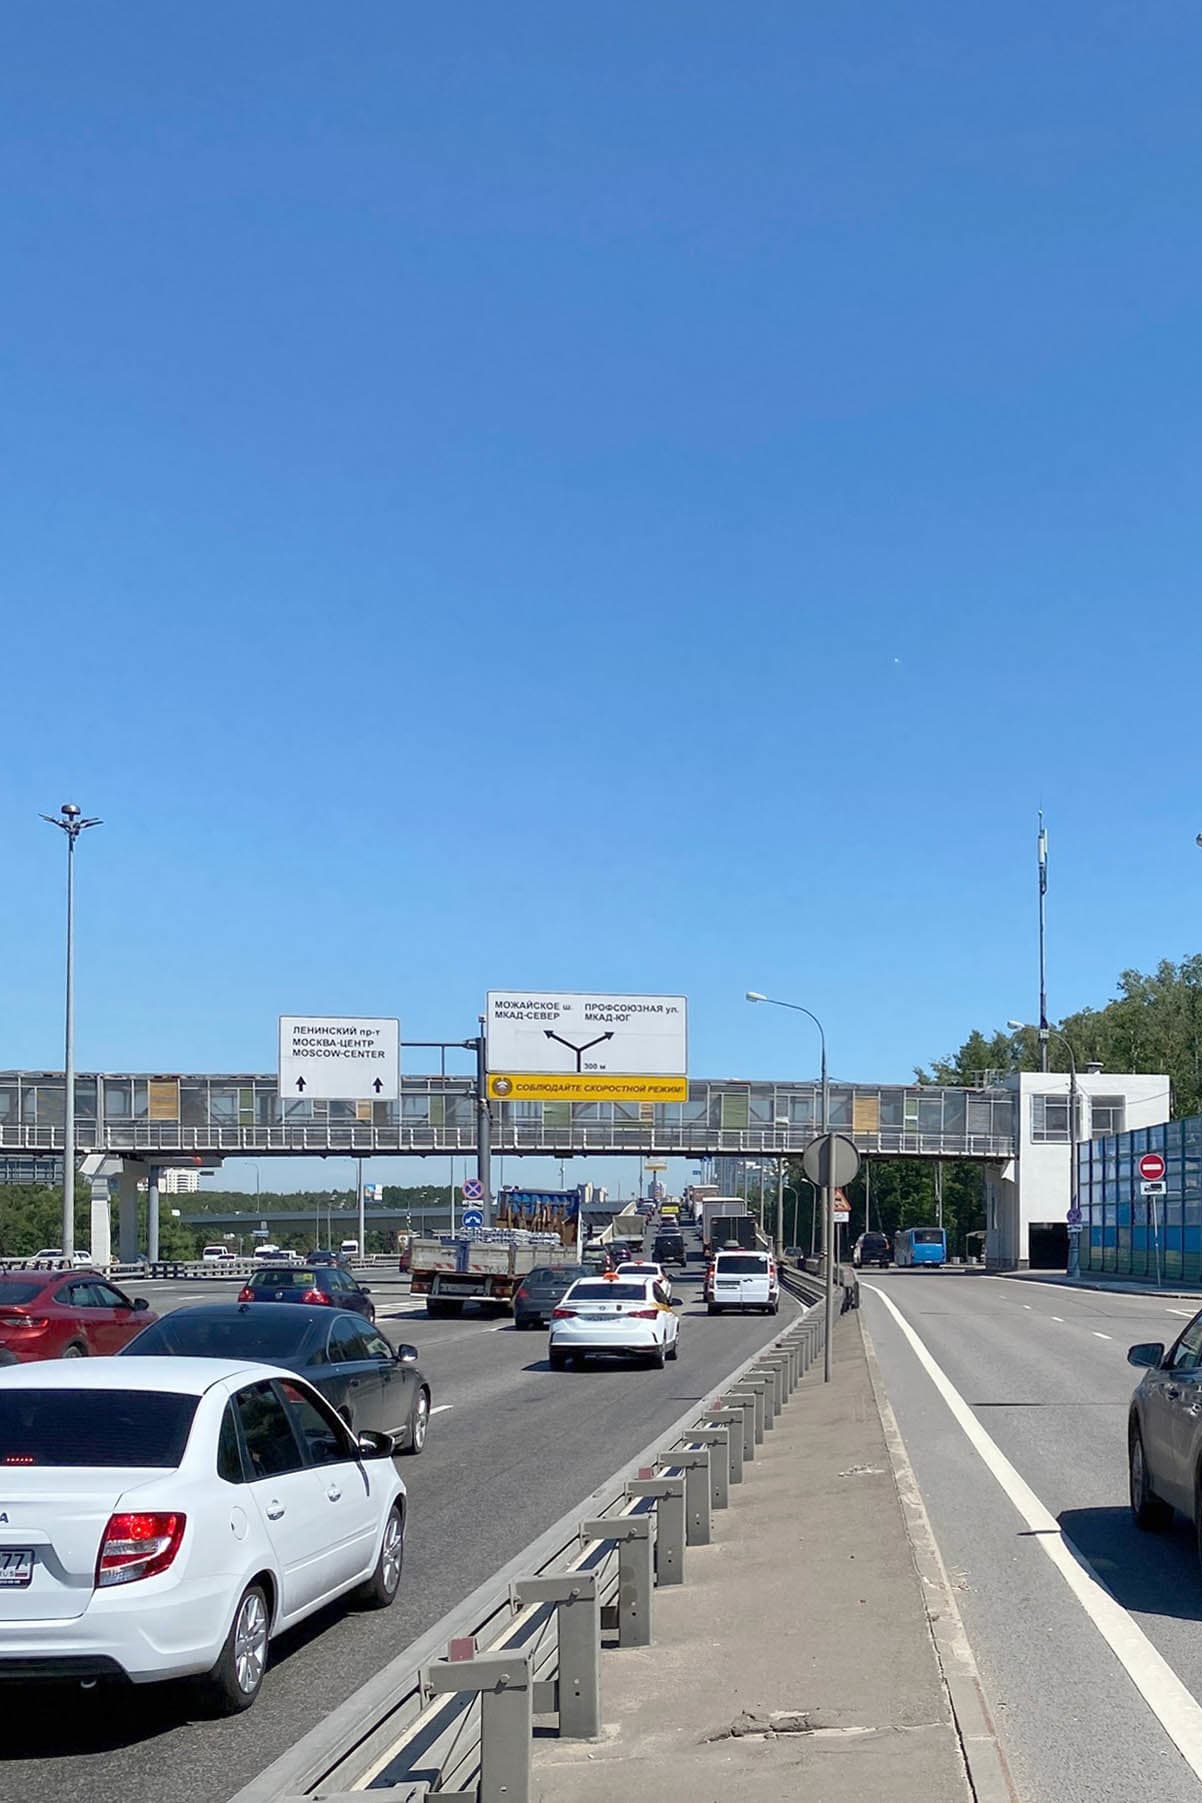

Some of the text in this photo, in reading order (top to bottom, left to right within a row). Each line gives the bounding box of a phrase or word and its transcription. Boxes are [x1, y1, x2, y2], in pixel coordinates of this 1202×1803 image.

[494, 1000, 560, 1011] МОЖАЙСКОЕ
[584, 1003, 664, 1014] ПРОФСОЮЗНАЯ
[494, 1011, 561, 1021] МКАД-СЕВЕР
[584, 1013, 632, 1023] МКАД-ЮГ
[292, 1025, 381, 1038] ЛЕНИНСКИЙ пр-т
[292, 1038, 375, 1048] МОСКВА-ЦЕНТР
[292, 1048, 386, 1059] MOSCOW-CENTER
[515, 1082, 581, 1092] СОБЛЮДАЙТЕ
[583, 1084, 646, 1093] СКОРОСТНОЙ
